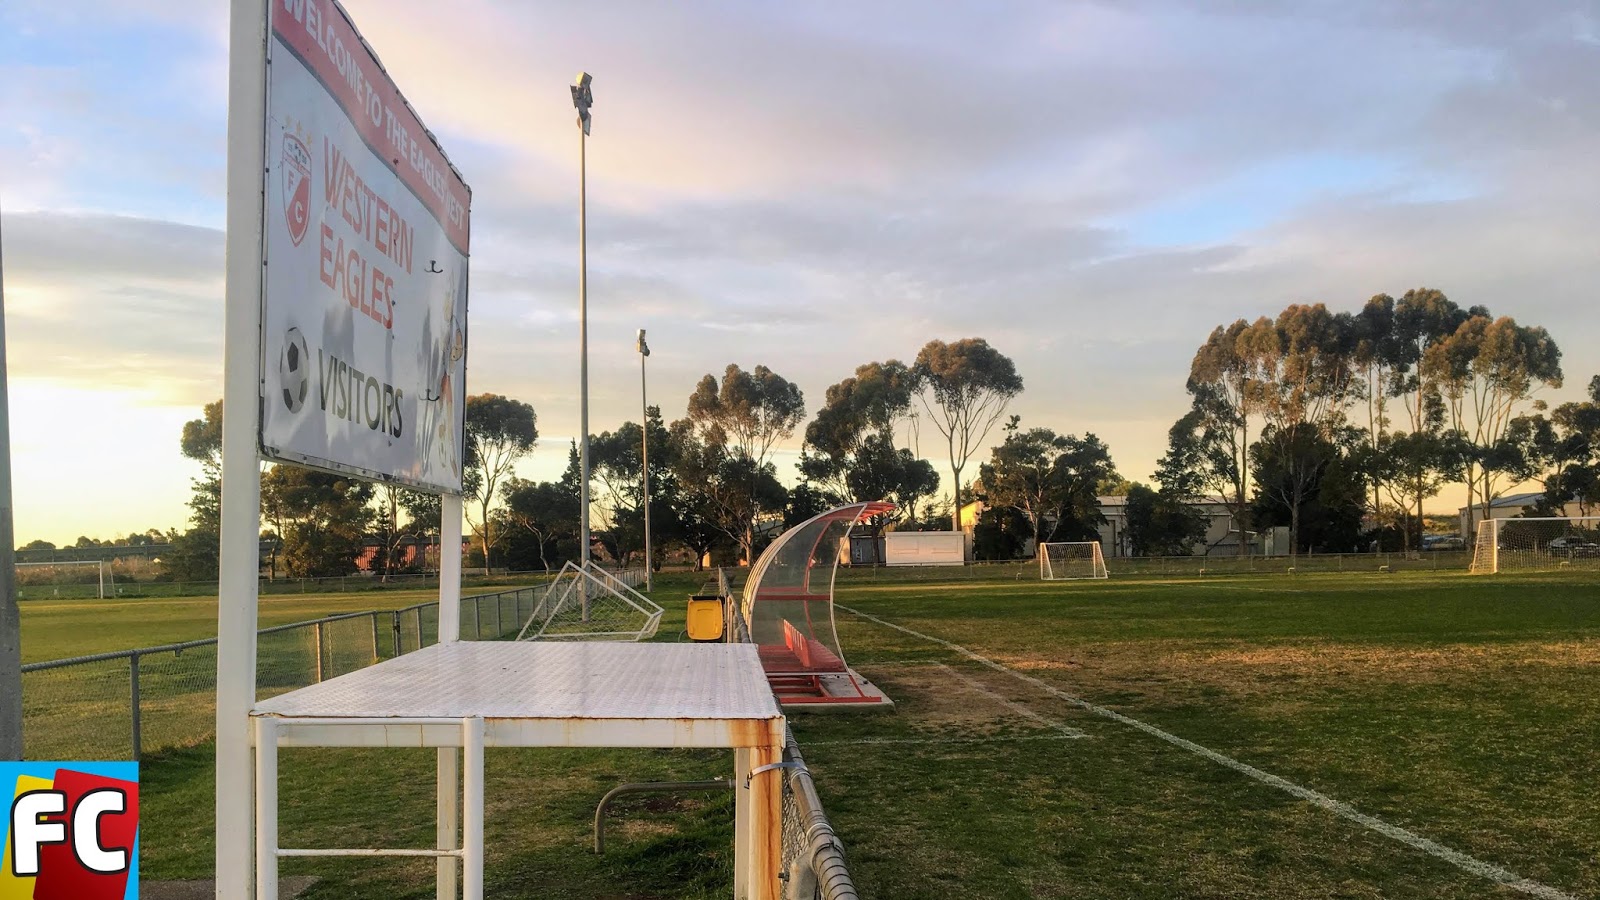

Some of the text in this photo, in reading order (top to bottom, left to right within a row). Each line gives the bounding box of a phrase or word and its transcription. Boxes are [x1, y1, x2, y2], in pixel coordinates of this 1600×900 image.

[284, 0, 363, 105] WELCOME
[365, 79, 382, 127] TO
[385, 106, 407, 160] THE
[324, 135, 413, 275] WESTERN
[319, 221, 394, 329] EAGLES
[318, 348, 403, 438] VISITORS
